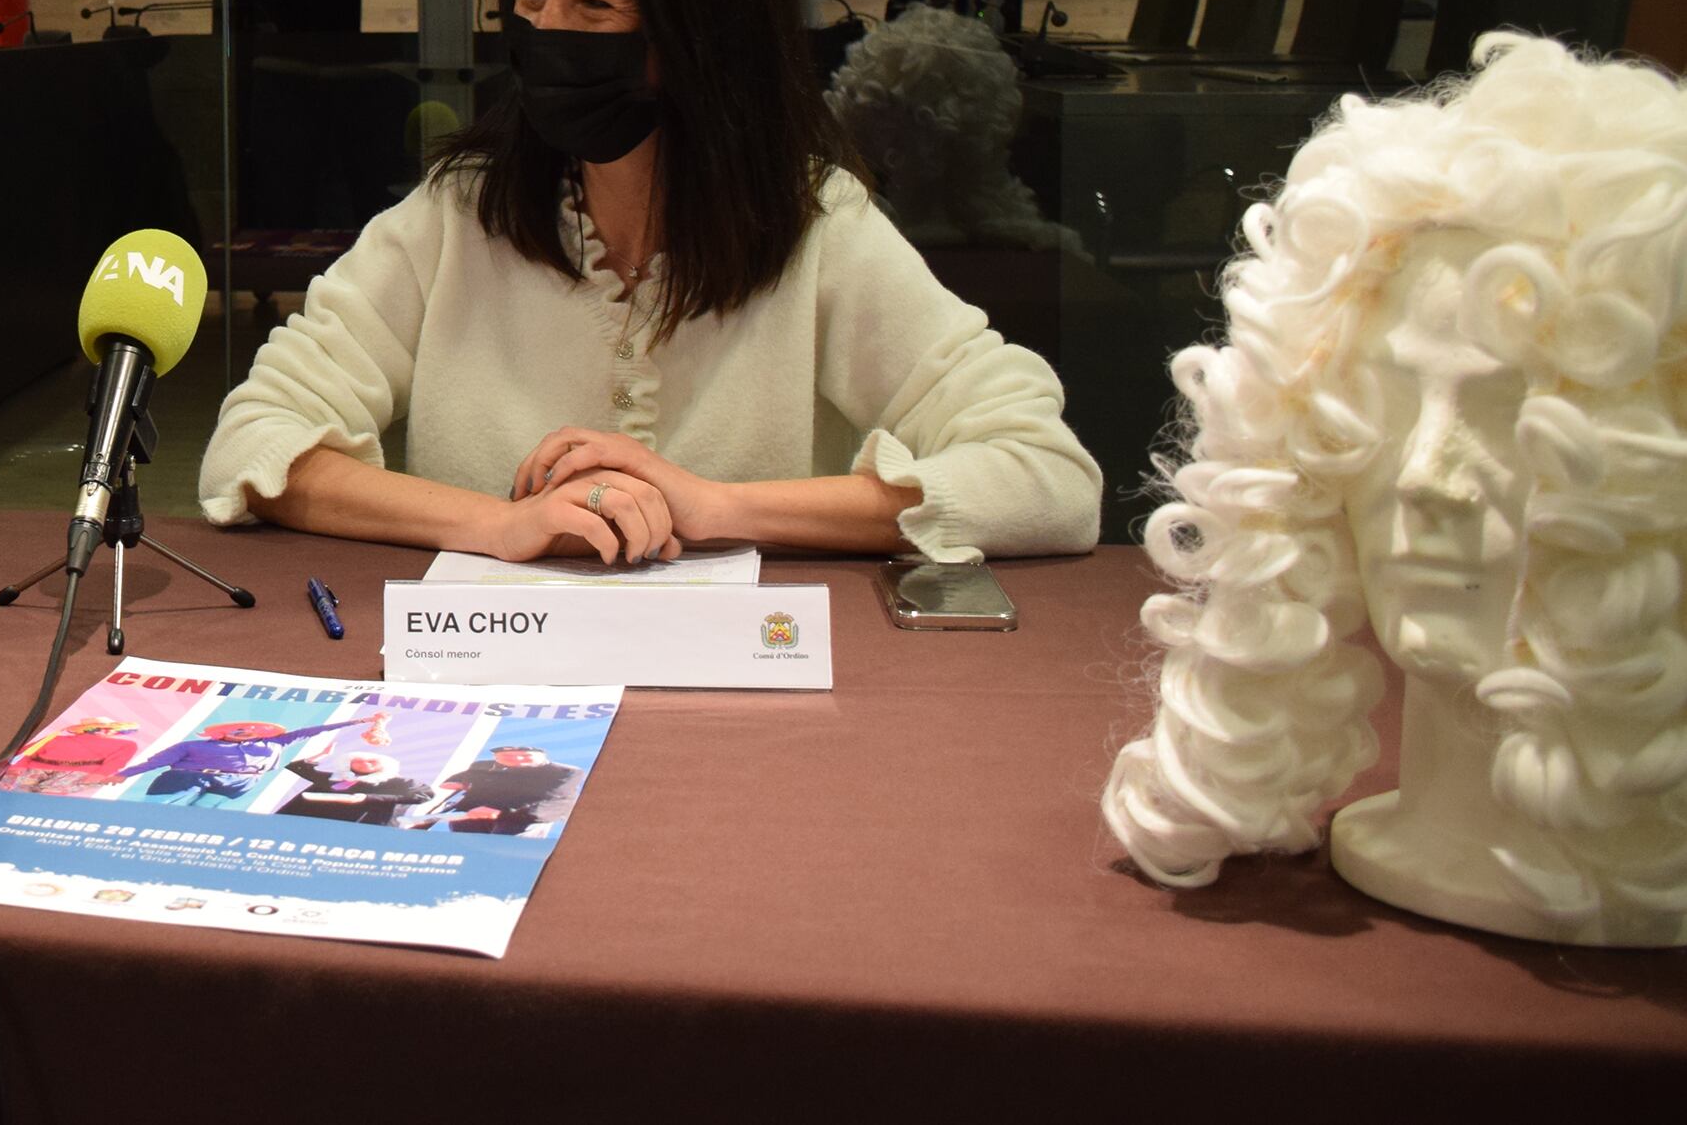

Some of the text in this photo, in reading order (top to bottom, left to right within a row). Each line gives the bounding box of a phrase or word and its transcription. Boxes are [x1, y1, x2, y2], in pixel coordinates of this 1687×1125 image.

[94, 251, 185, 307] ANA
[407, 611, 549, 633] EVA CHOY
[405, 648, 481, 659] Cònsol menor
[752, 651, 809, 660] Comú d'Ordino
[105, 670, 617, 721] CONTRABANDISTES
[343, 683, 387, 693] 2022
[6, 815, 464, 865] DILLUNS 28 FEBRER / 12 h PLAÇA MAJOR
[84, 835, 112, 845] per
[246, 852, 307, 864] Cultura
[312, 859, 378, 871] Popular
[36, 838, 72, 847] Amb
[138, 847, 170, 857] Valls
[176, 851, 201, 859] del
[205, 854, 244, 865] Nord,
[270, 861, 312, 871] Coral
[316, 865, 408, 879] Casamanya
[139, 853, 177, 865] Grup
